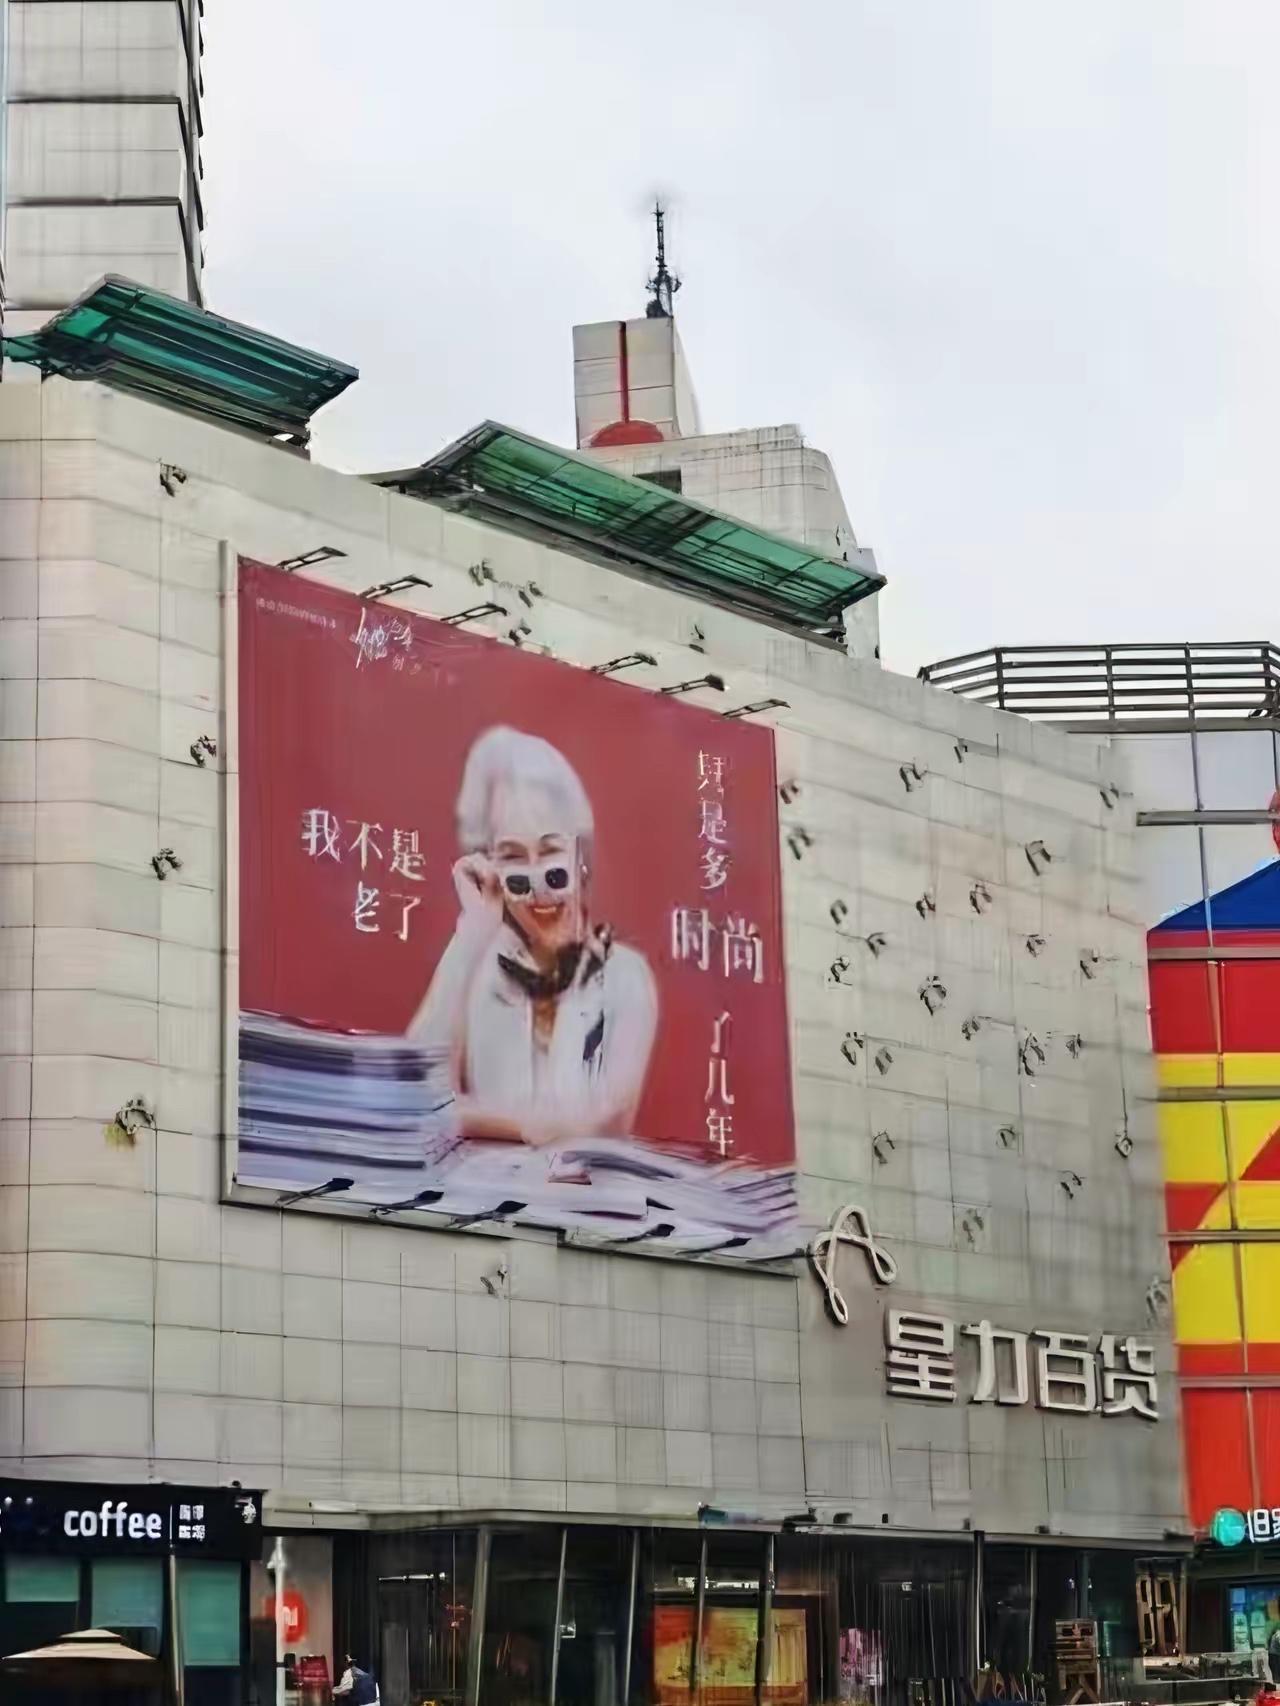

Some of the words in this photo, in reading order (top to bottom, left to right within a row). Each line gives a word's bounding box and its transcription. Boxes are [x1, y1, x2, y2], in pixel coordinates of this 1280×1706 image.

[300, 807, 426, 881] 我不是
[353, 881, 421, 942] 老了
[671, 906, 764, 984] 时尚
[886, 1308, 1160, 1422] 星力百货
[64, 1500, 162, 1539] coffee
